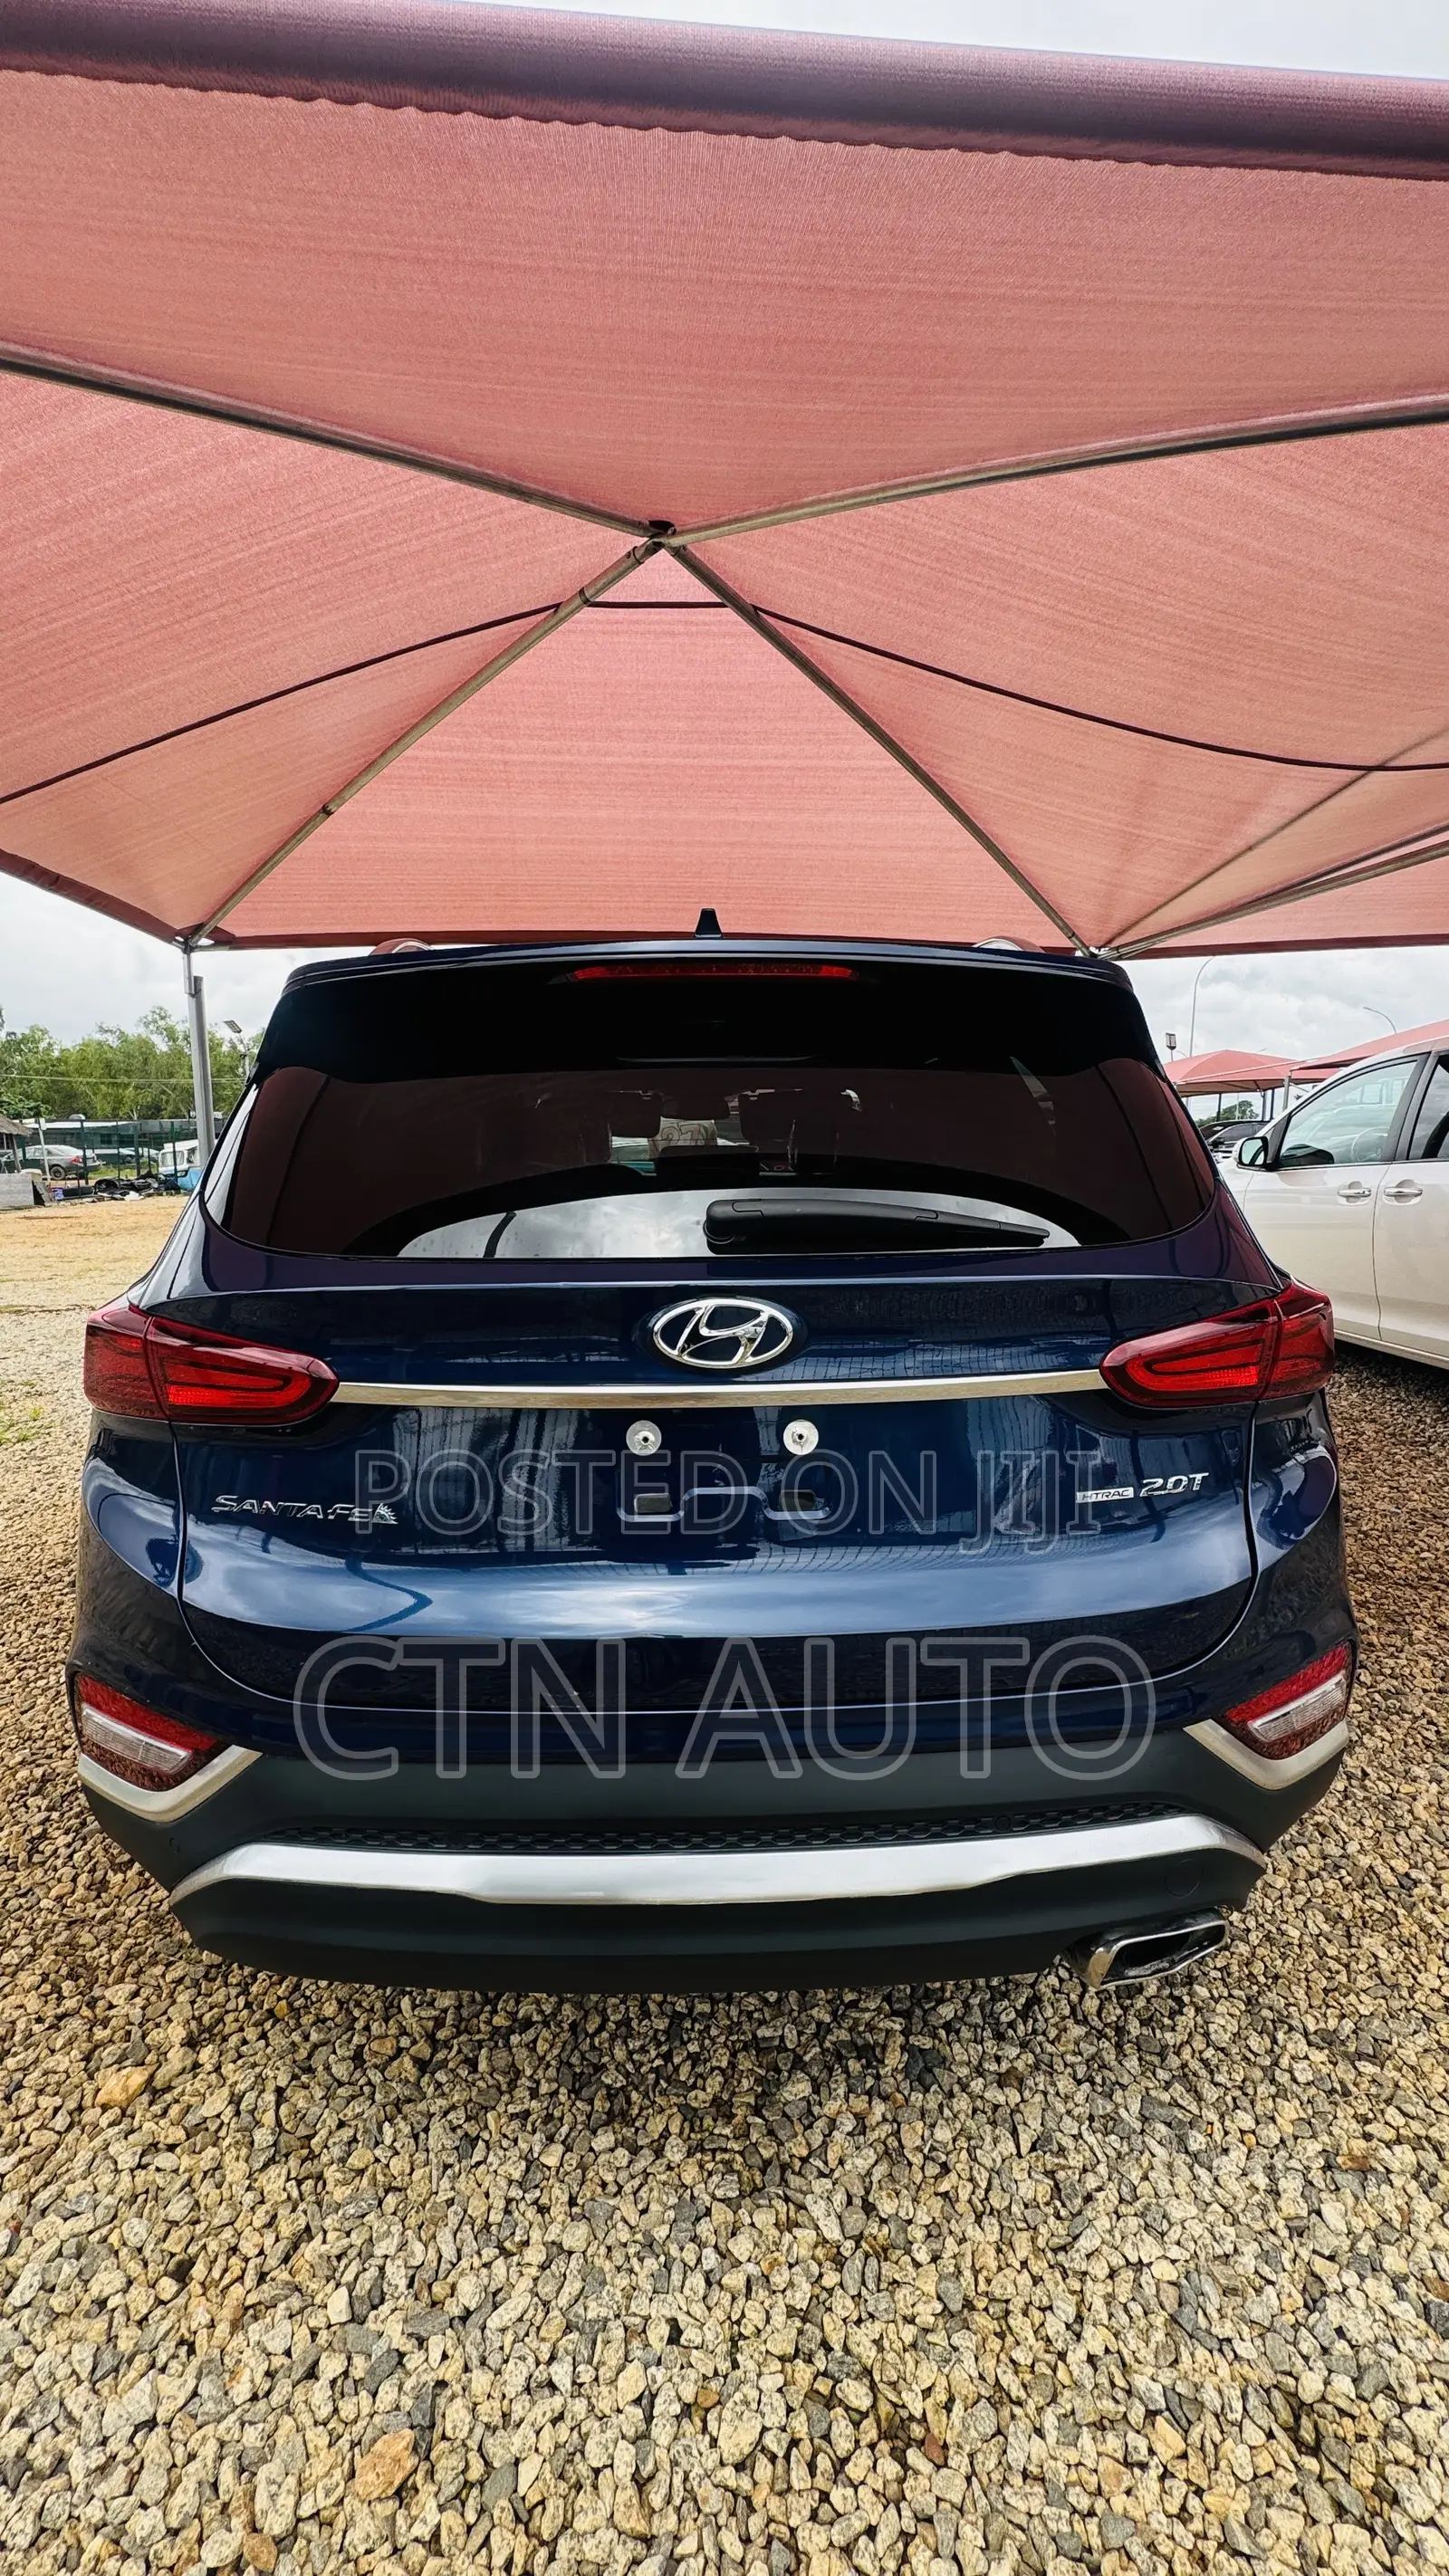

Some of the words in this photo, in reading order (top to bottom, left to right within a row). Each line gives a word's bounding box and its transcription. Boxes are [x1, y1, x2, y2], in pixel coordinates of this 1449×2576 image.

[1081, 1489, 1131, 1501] HTRAC
[211, 1495, 324, 1519] SANTA
[327, 1504, 373, 1522] FE
